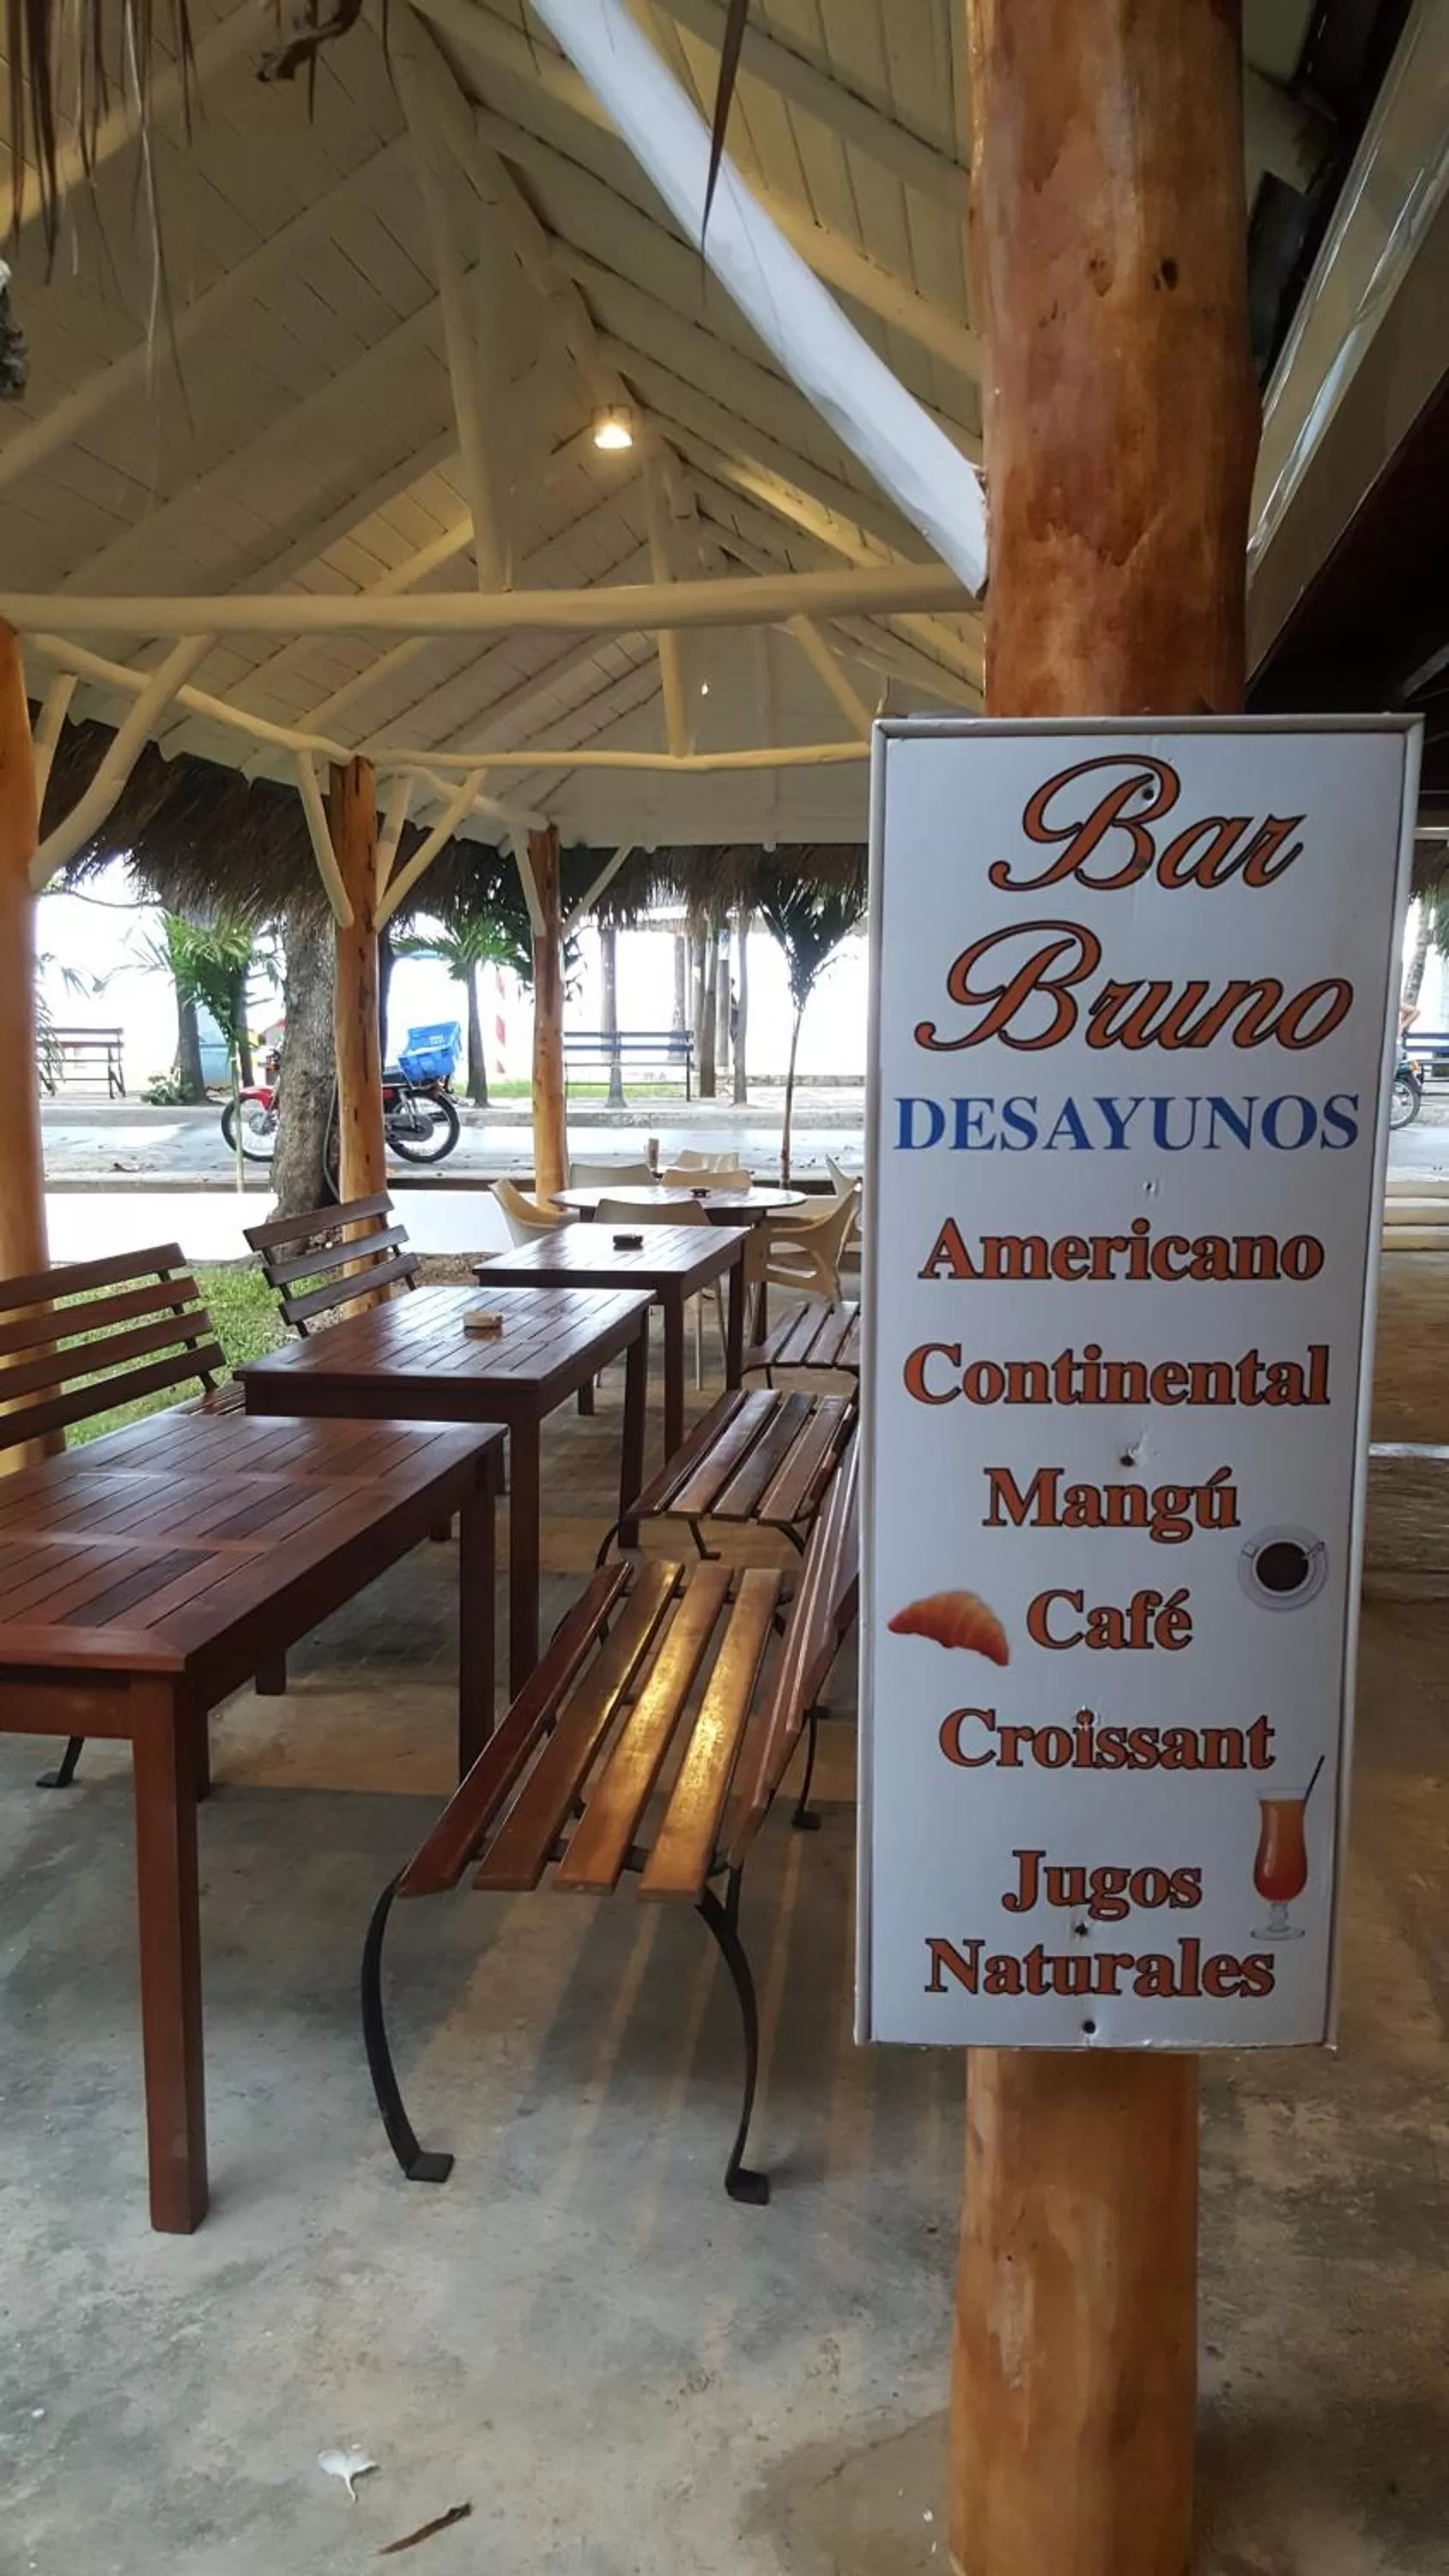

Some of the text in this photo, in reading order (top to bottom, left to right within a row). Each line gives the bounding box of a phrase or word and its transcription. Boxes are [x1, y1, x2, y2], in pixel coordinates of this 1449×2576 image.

[988, 754, 1307, 891] Bar
[914, 920, 1355, 1051] Bruno
[894, 1093, 1360, 1151] DESAYUNOS
[918, 1218, 1325, 1281] Americano
[904, 1343, 1331, 1407] Continental
[982, 1466, 1241, 1544] Mangú
[1027, 1588, 1194, 1650] Café
[939, 1708, 1277, 1771] Croissant
[1001, 1850, 1203, 1922] Jugos
[925, 1938, 1276, 1998] Naturales
